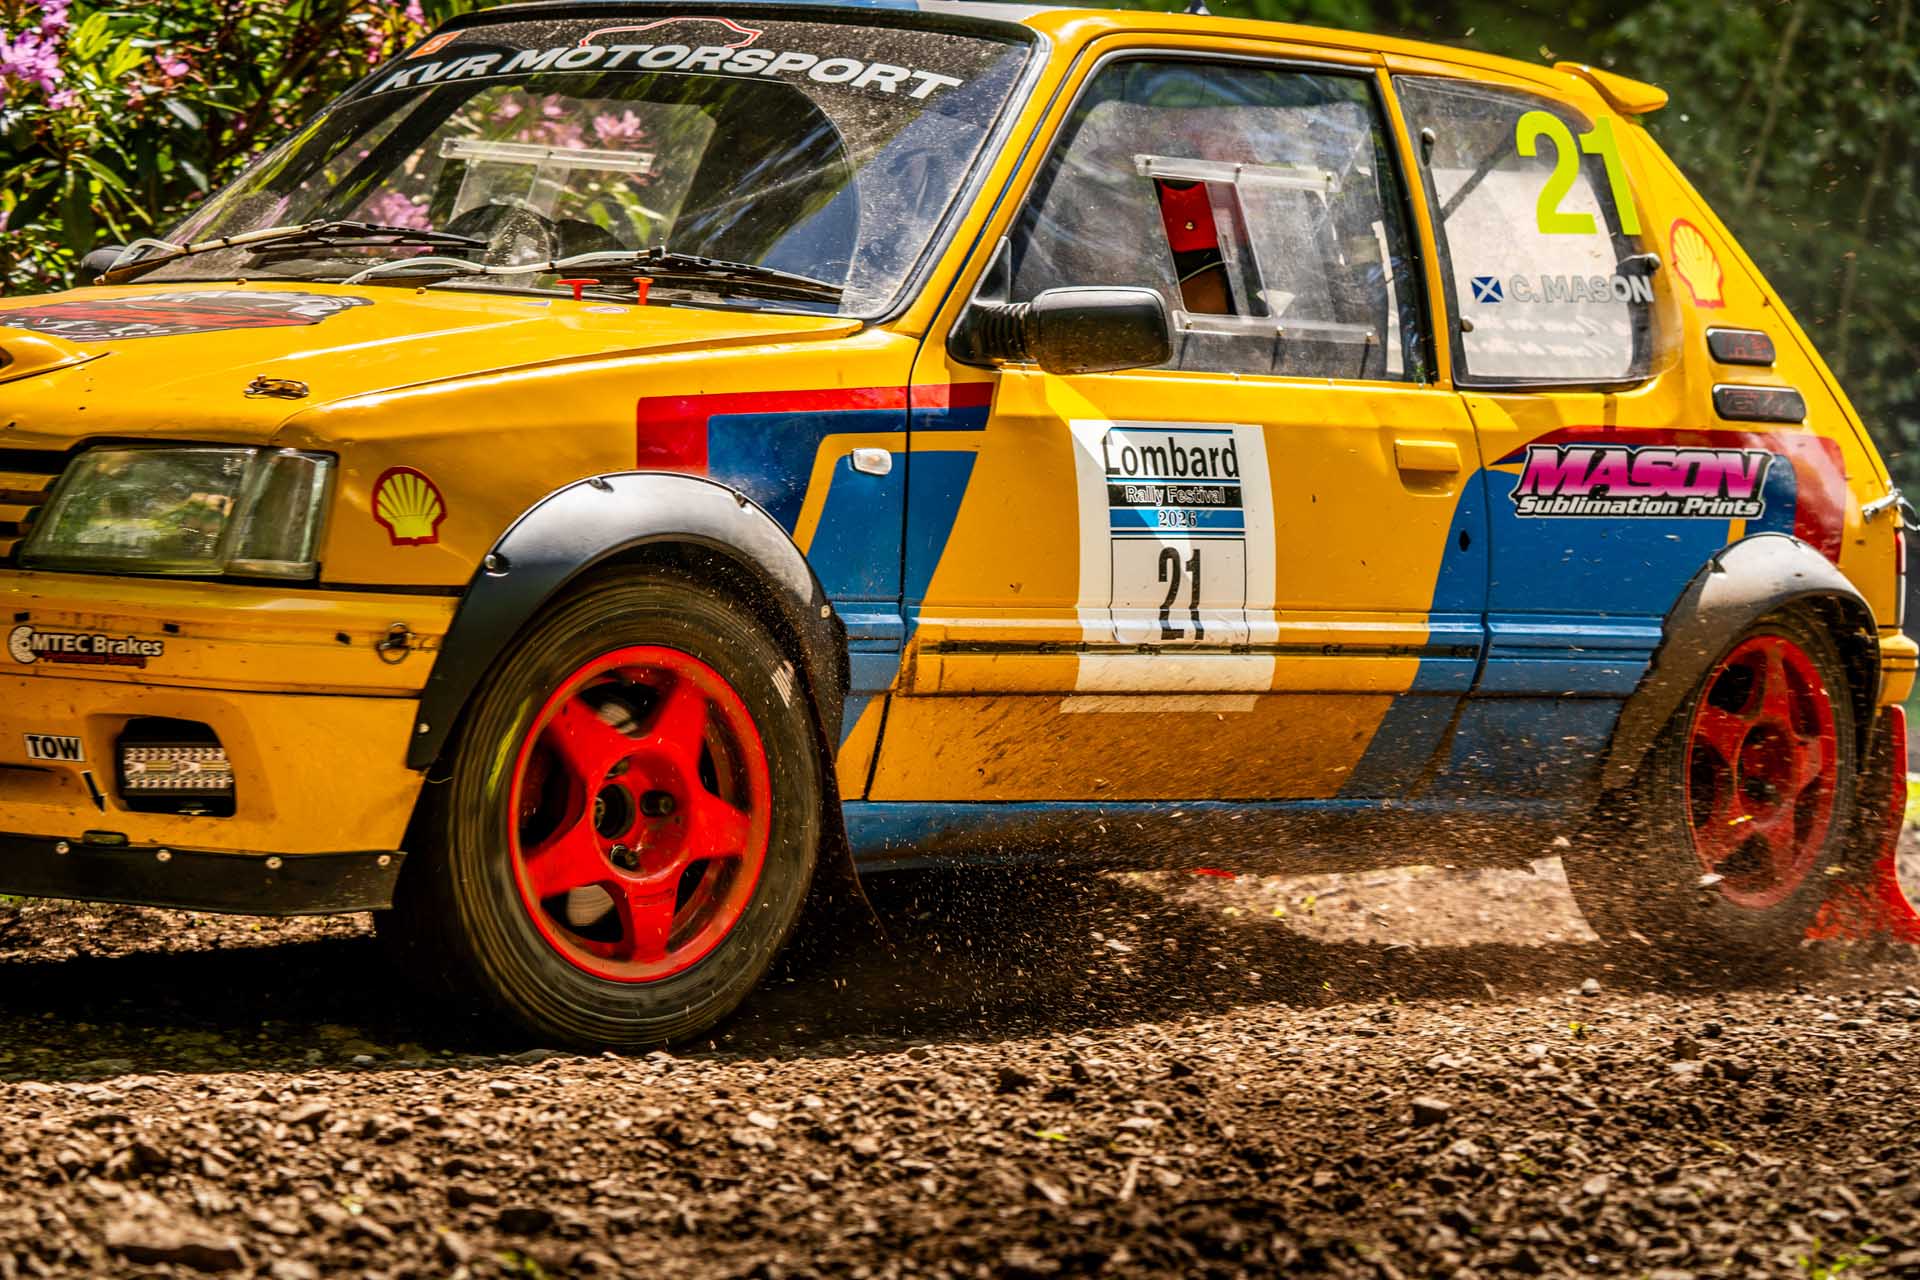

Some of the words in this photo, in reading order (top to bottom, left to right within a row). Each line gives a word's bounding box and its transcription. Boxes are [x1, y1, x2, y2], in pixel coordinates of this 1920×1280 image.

[372, 54, 502, 94] KVR
[497, 45, 964, 98] MOTORSPORT
[1515, 110, 1642, 236] 21
[1510, 275, 1541, 302] C.
[1542, 275, 1655, 303] MASON
[1103, 437, 1240, 477] Lombard
[1518, 447, 1764, 498] MASON
[1125, 485, 1163, 506] Rally
[1167, 486, 1226, 504] Festival
[1517, 496, 1679, 515] Sublimation
[1681, 497, 1762, 517] Prints
[1158, 511, 1198, 526] 2026
[1158, 547, 1204, 640] 21
[32, 633, 90, 652] MTEC
[92, 636, 163, 656] Brakes
[28, 736, 80, 760] TOW
